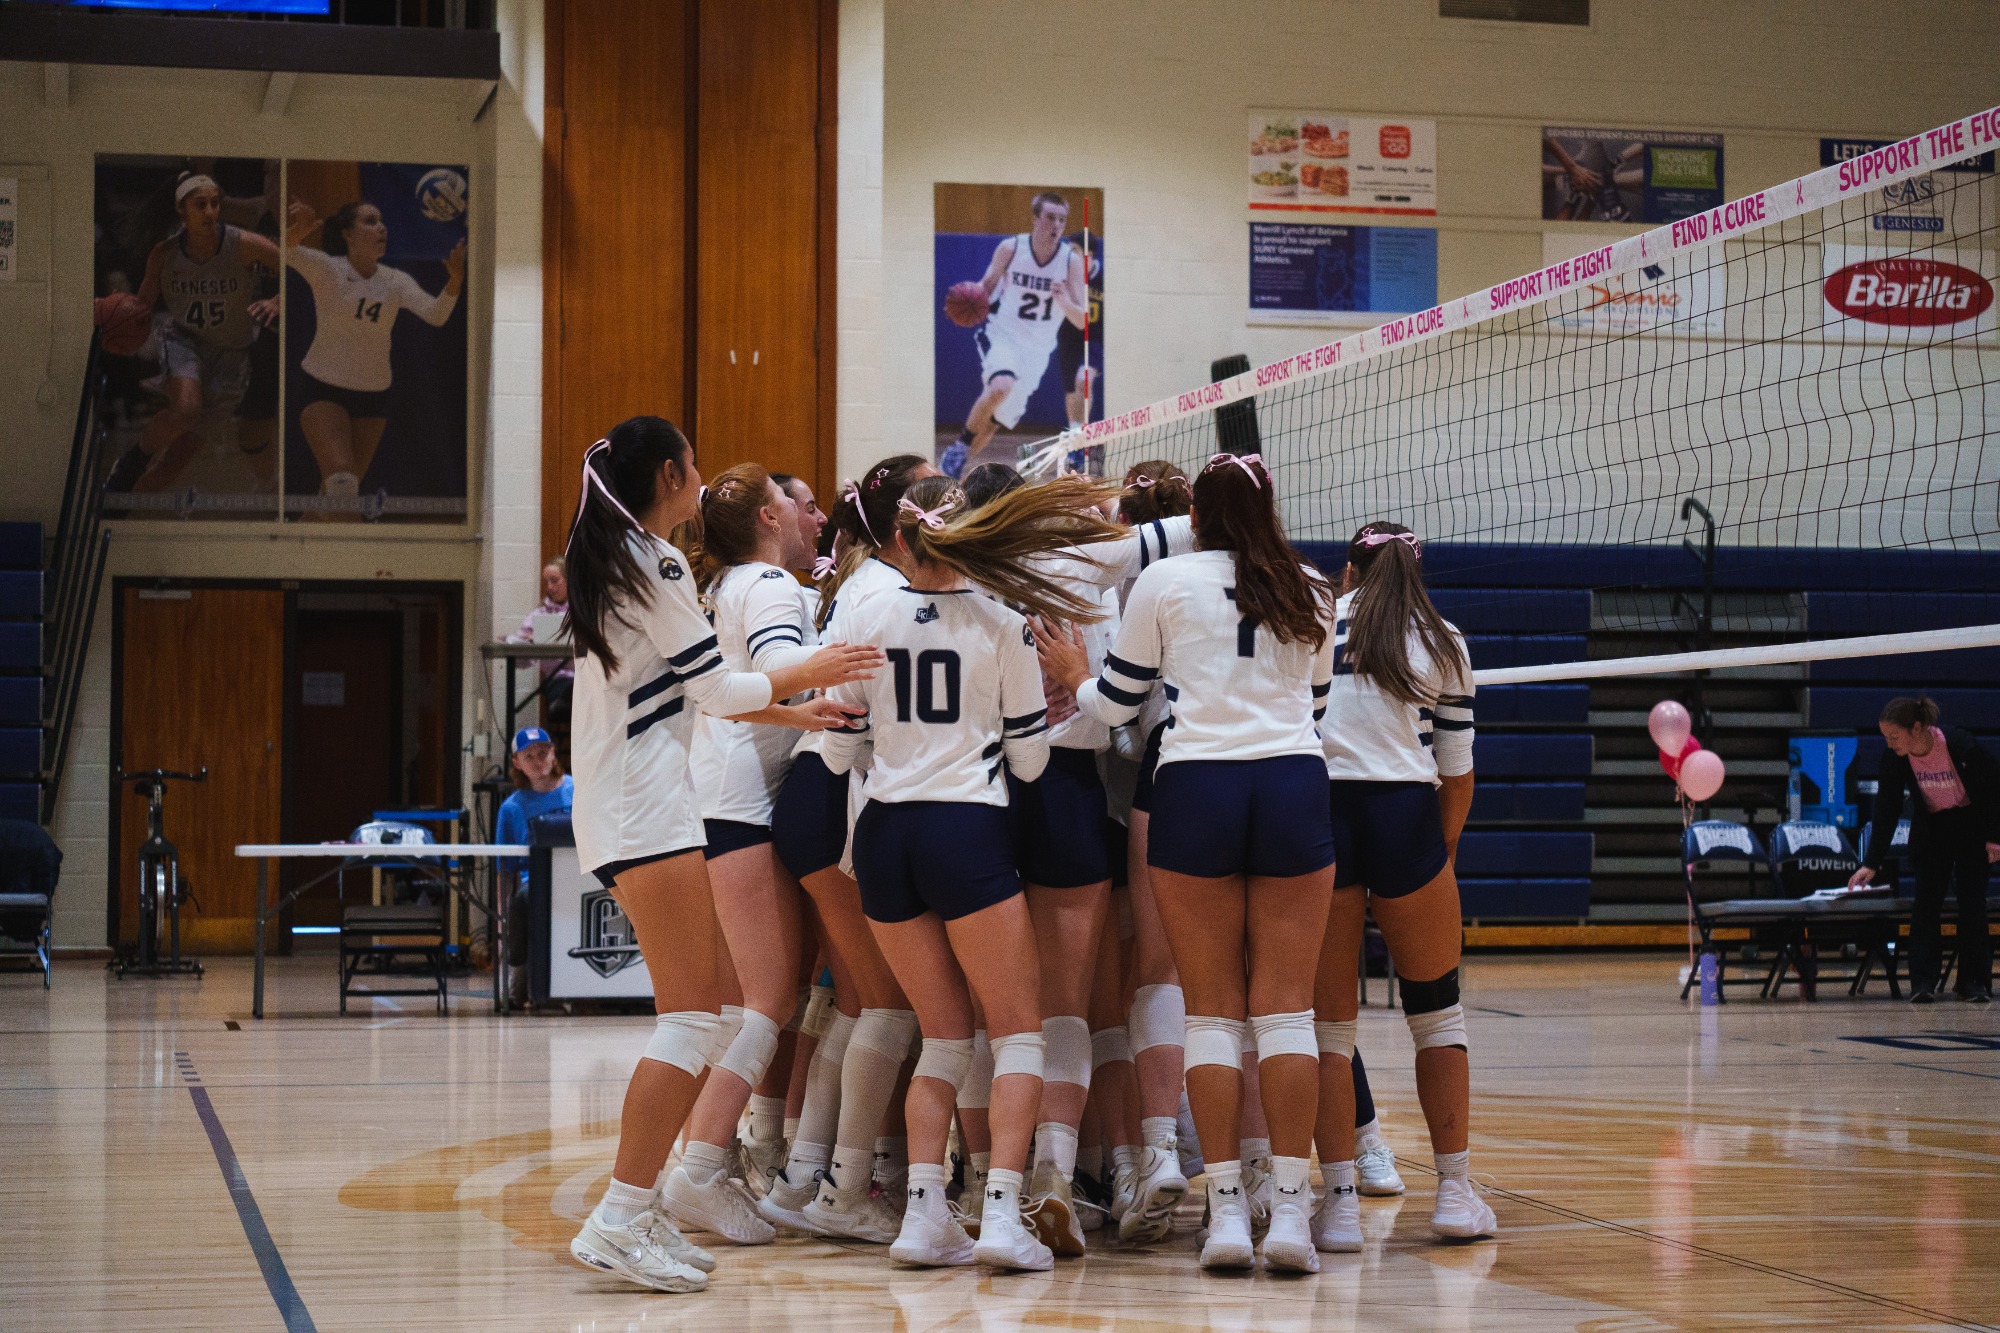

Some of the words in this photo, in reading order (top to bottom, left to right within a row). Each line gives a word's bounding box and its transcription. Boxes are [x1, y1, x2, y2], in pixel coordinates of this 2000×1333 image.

[1840, 137, 1921, 192] SUPPORT
[1926, 122, 1964, 160] THE
[1672, 214, 1707, 248] FIND
[1712, 211, 1722, 236] A
[1725, 192, 1766, 231] CURE
[1886, 217, 1942, 230] GENESEO
[1490, 272, 1543, 311] SUPPORT
[1546, 264, 1570, 291] THE
[1573, 246, 1613, 282] FIGHT
[1880, 261, 1904, 272] DAL
[1909, 261, 1938, 273] 1877
[354, 297, 383, 323] 14
[1018, 292, 1054, 322] 21
[1844, 273, 1972, 310] Barilla
[185, 300, 226, 329] 45
[1381, 321, 1405, 346] FIND
[1407, 317, 1415, 338] A
[1416, 306, 1444, 336] CURE
[1256, 358, 1294, 387] SUPPORT
[1296, 352, 1312, 375] THE
[1315, 342, 1342, 369] FIGHT
[1178, 392, 1197, 413] FIND
[1198, 389, 1204, 407] A
[1205, 382, 1224, 403] CURE
[885, 648, 961, 724] 10
